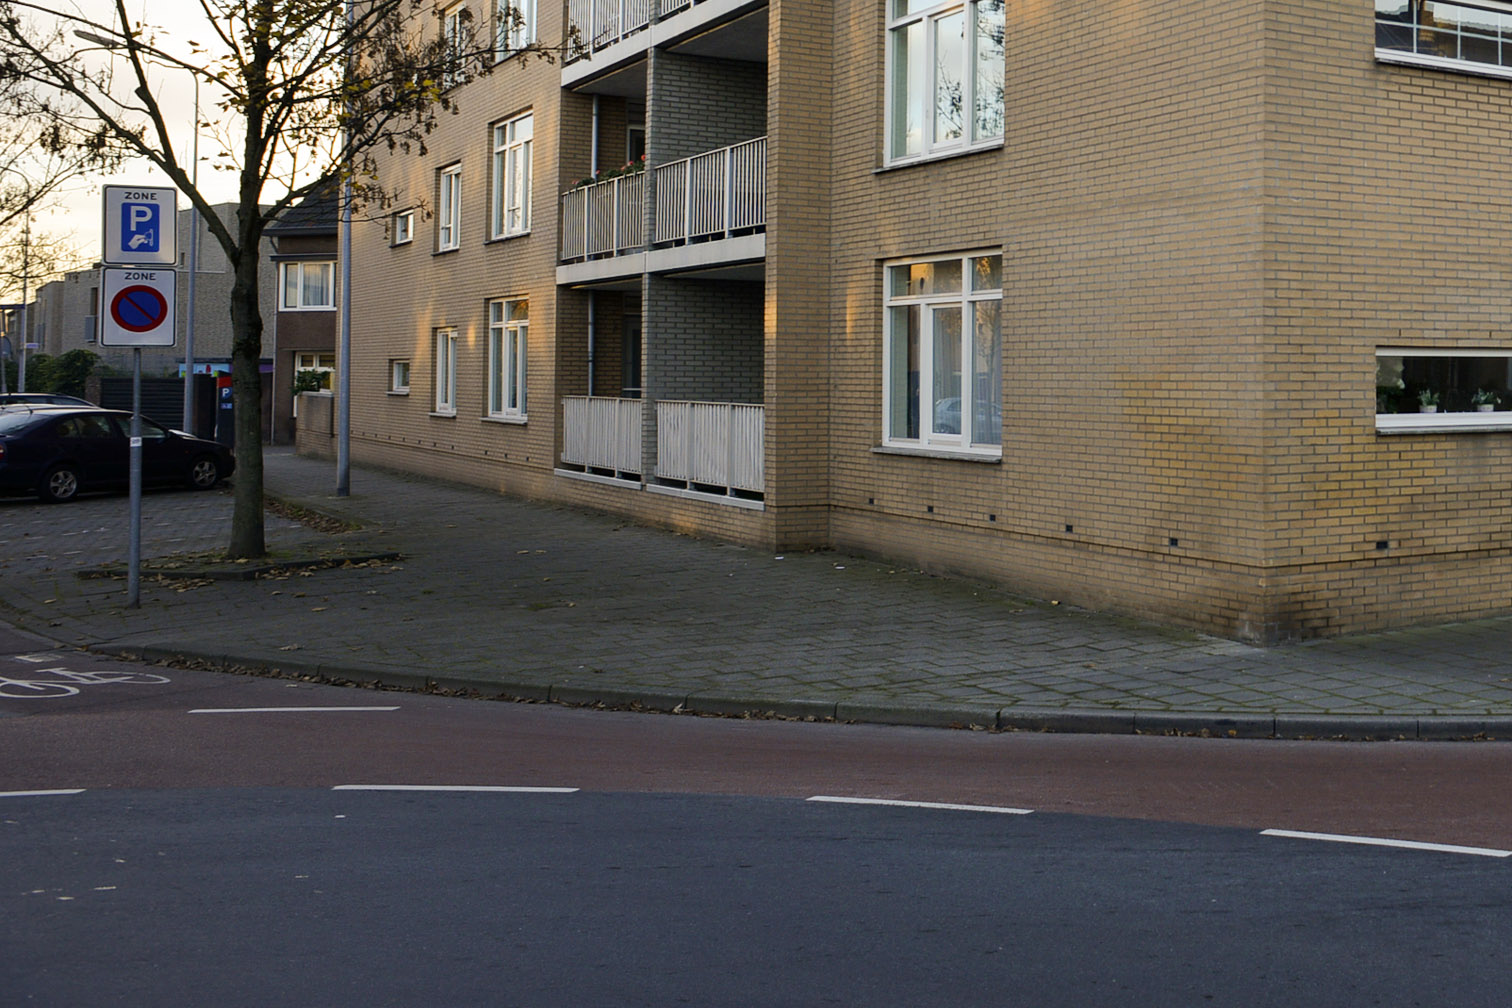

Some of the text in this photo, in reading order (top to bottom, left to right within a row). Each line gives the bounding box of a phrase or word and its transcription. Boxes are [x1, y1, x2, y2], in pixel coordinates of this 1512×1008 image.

[124, 192, 157, 201] ZONE
[130, 205, 153, 231] P
[124, 272, 157, 281] ZONE
[222, 387, 230, 398] P
